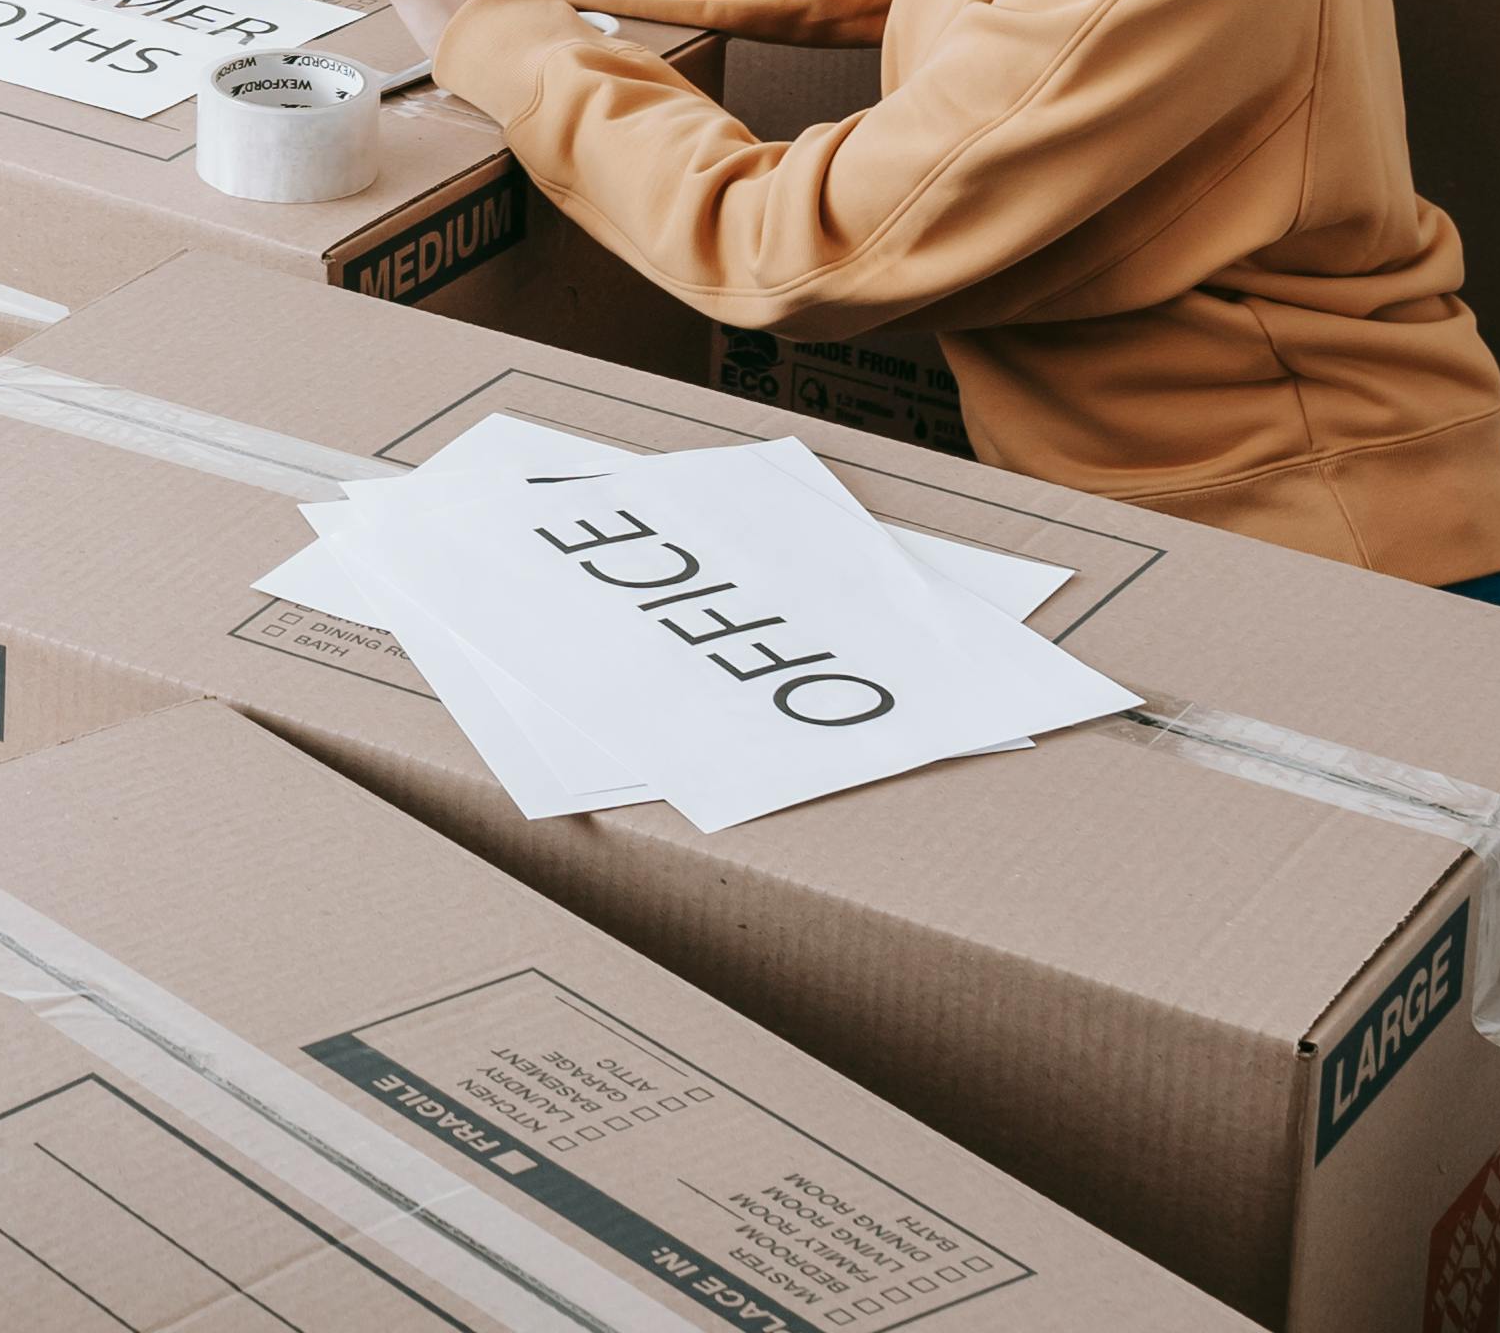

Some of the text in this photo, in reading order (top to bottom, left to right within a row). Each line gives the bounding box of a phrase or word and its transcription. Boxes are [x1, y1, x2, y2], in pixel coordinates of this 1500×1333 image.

[245, 79, 312, 92] WEXFORD
[360, 189, 511, 301] MEDIUM
[720, 363, 780, 399] ECO
[792, 341, 853, 365] MADE
[858, 350, 917, 382] FROM
[294, 635, 349, 657] BATH
[310, 622, 382, 650] DINING
[532, 509, 895, 727] OFFICE
[1332, 934, 1452, 1124] LARGE
[476, 1066, 575, 1123] LAUNDRY
[491, 1048, 603, 1113] BASEMENT
[541, 1051, 628, 1103] GARAGE
[596, 1058, 659, 1093] ATTIC
[371, 1074, 502, 1153] FRAGILE
[457, 1078, 548, 1133] KITCHEN
[729, 1193, 878, 1284] FAMILY ROOM
[761, 1186, 904, 1273] LIVING ROOM
[784, 1173, 931, 1263] DINING ROOM
[896, 1215, 959, 1252] BATH
[729, 1247, 823, 1305] MASTER
[735, 1223, 850, 1294] BEDROOM
[650, 1245, 793, 1333] LACE IN:
